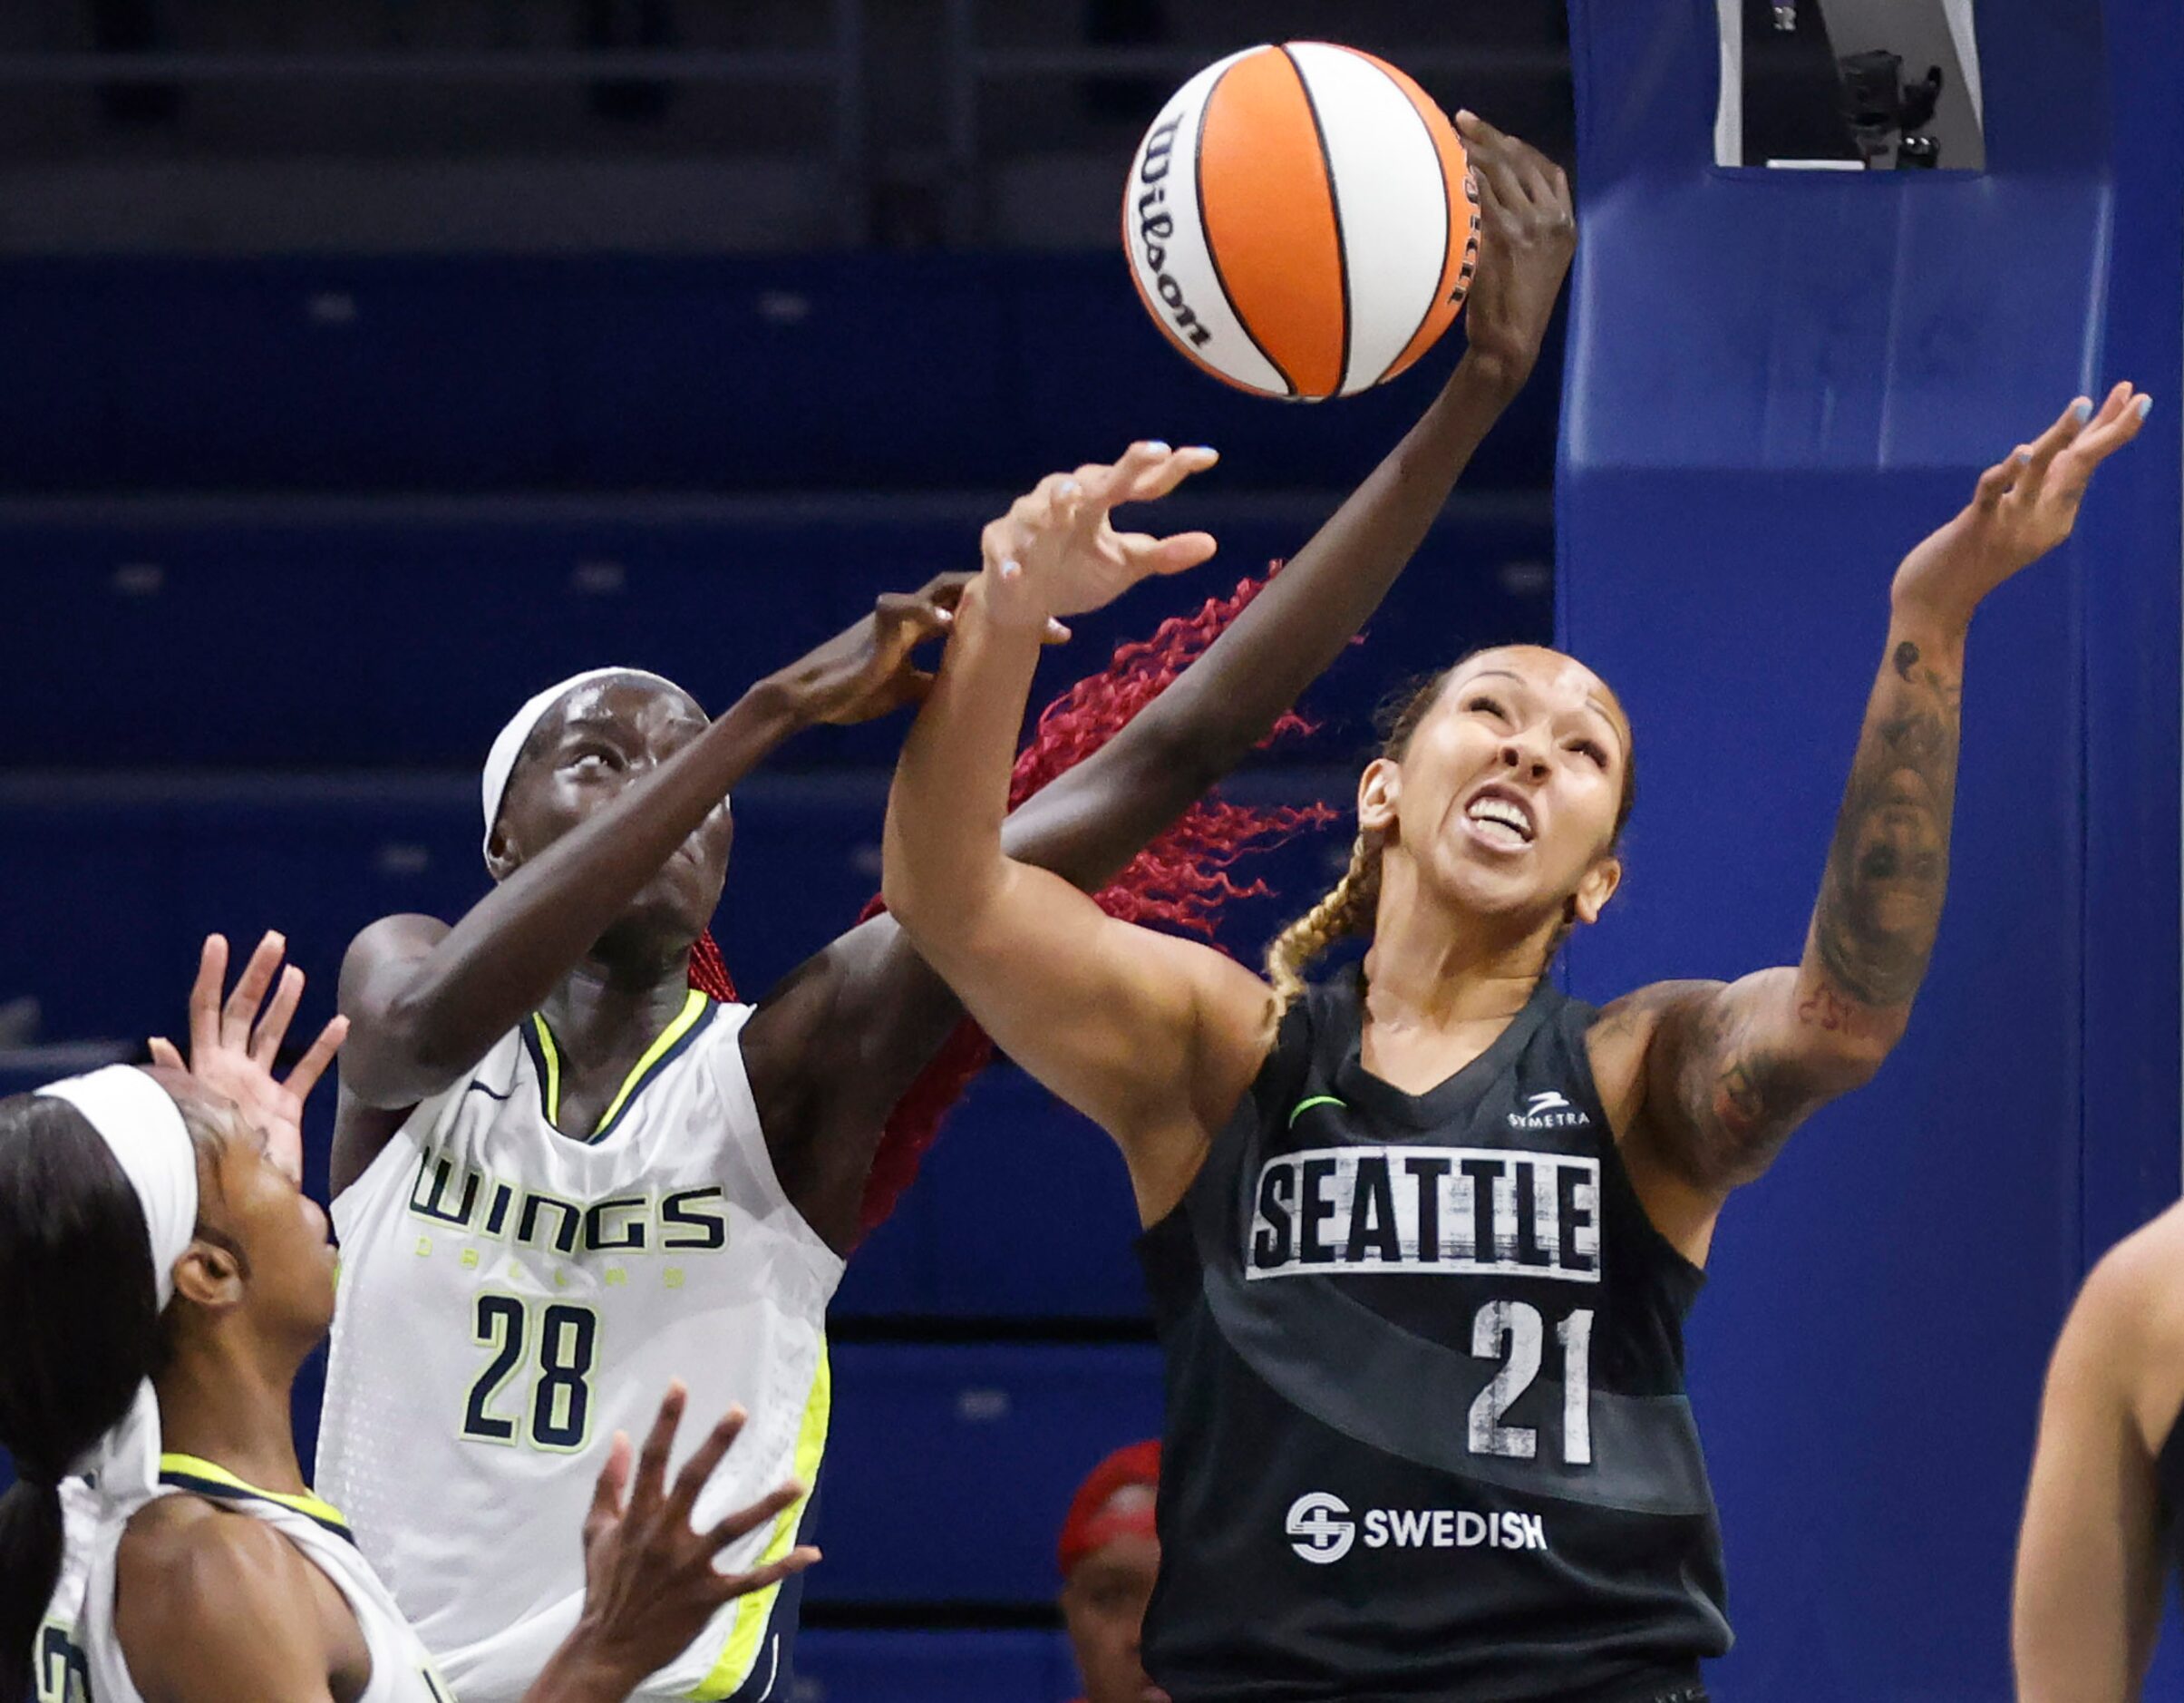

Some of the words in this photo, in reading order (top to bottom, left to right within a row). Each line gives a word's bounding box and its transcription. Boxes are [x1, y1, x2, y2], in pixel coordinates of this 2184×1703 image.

[1139, 111, 1212, 350] Wilson
[1507, 1112, 1591, 1129] SYMETRA
[409, 1146, 728, 1255] WINGS
[1253, 1156, 1594, 1273] SEATTLE
[461, 1290, 599, 1451] 28
[1467, 1299, 1595, 1465] 21
[1364, 1508, 1548, 1551] SWEDISH
